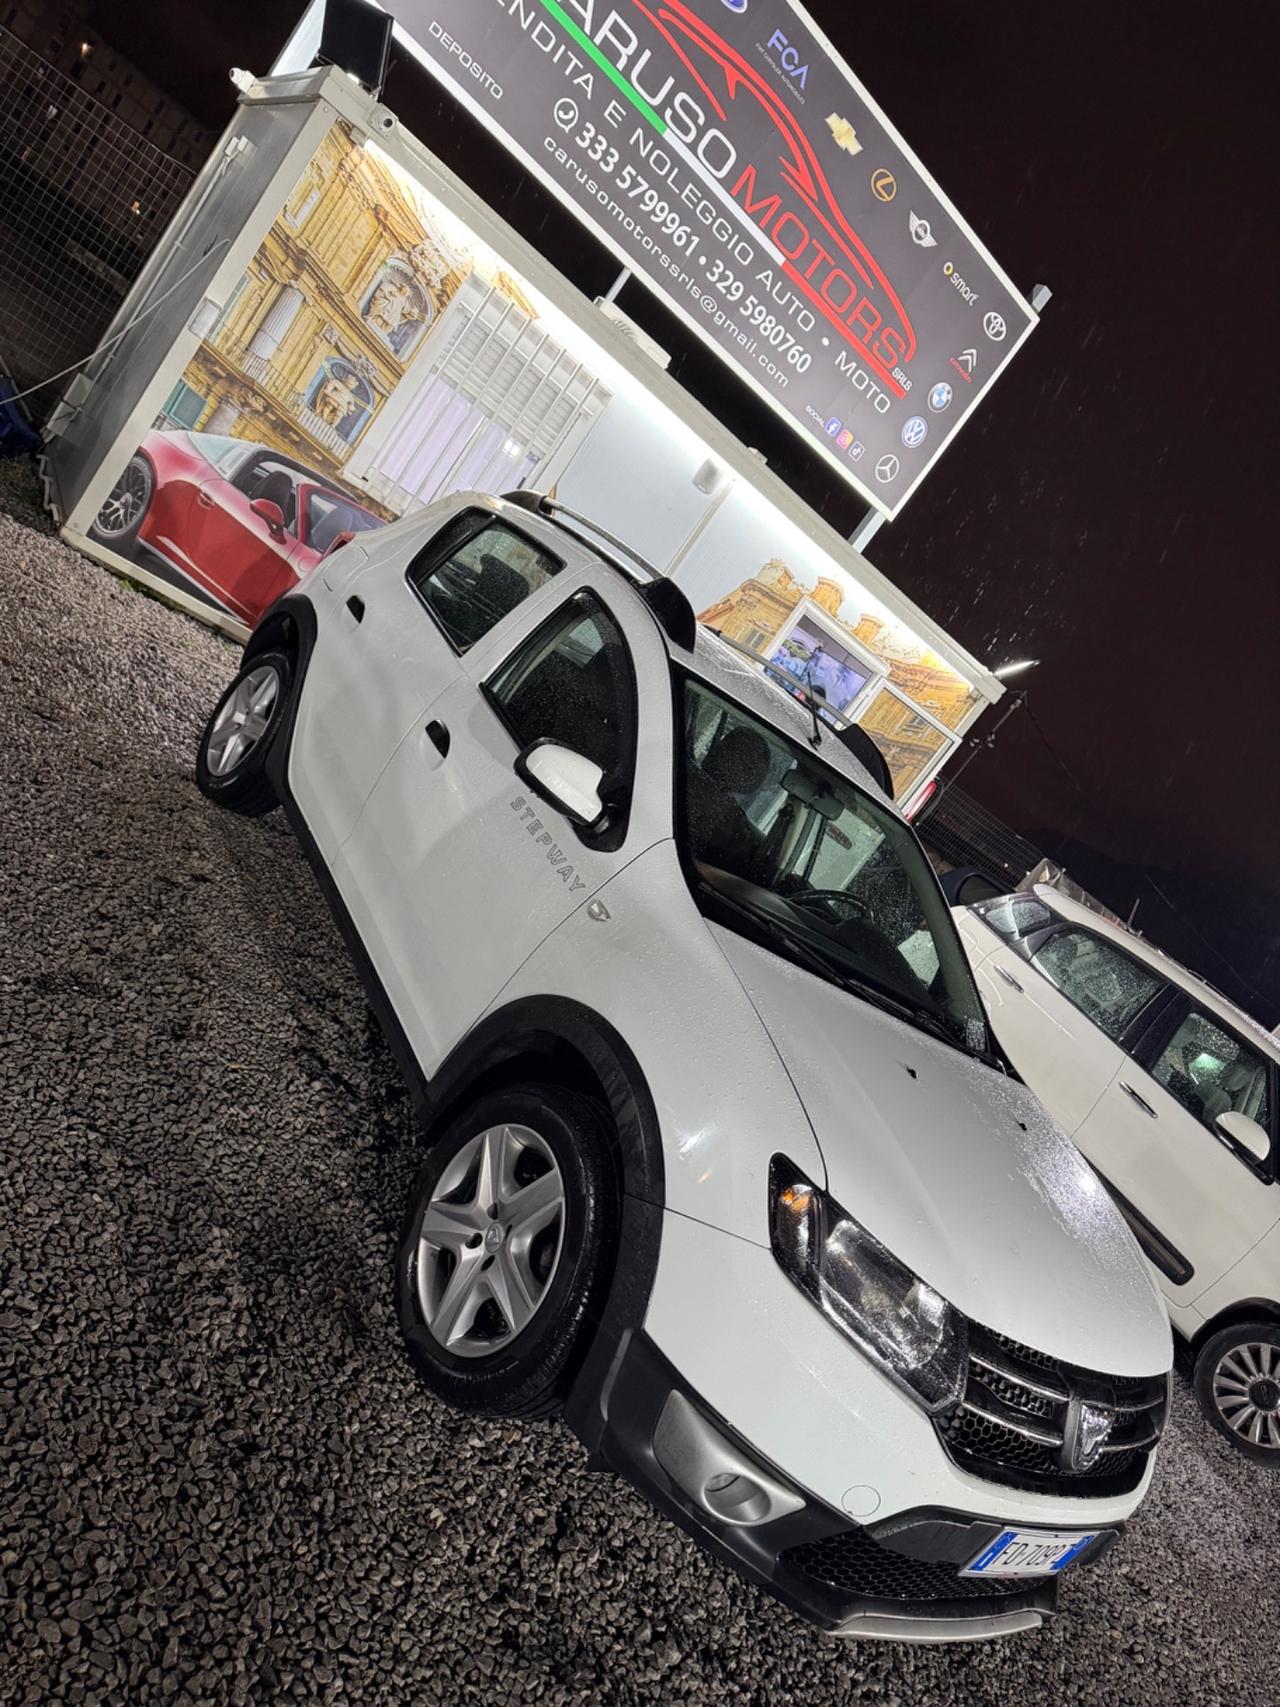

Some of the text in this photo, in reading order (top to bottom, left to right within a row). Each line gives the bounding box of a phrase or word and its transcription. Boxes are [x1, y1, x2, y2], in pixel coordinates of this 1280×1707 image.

[429, 21, 503, 99] DEPOSITO
[767, 28, 809, 90] FCA
[544, 137, 789, 387] carusomotorssrls@gmail.com
[575, 122, 812, 373] 333 5799961 329 5980760
[603, 100, 626, 128] E
[629, 127, 754, 266] NOLEGGIO
[755, 270, 815, 332] AUTO
[834, 351, 890, 414] MOTO
[731, 164, 906, 368] MOTORS
[891, 367, 913, 391] SRLS
[950, 272, 980, 306] smart
[510, 796, 586, 892] STEPWAY
